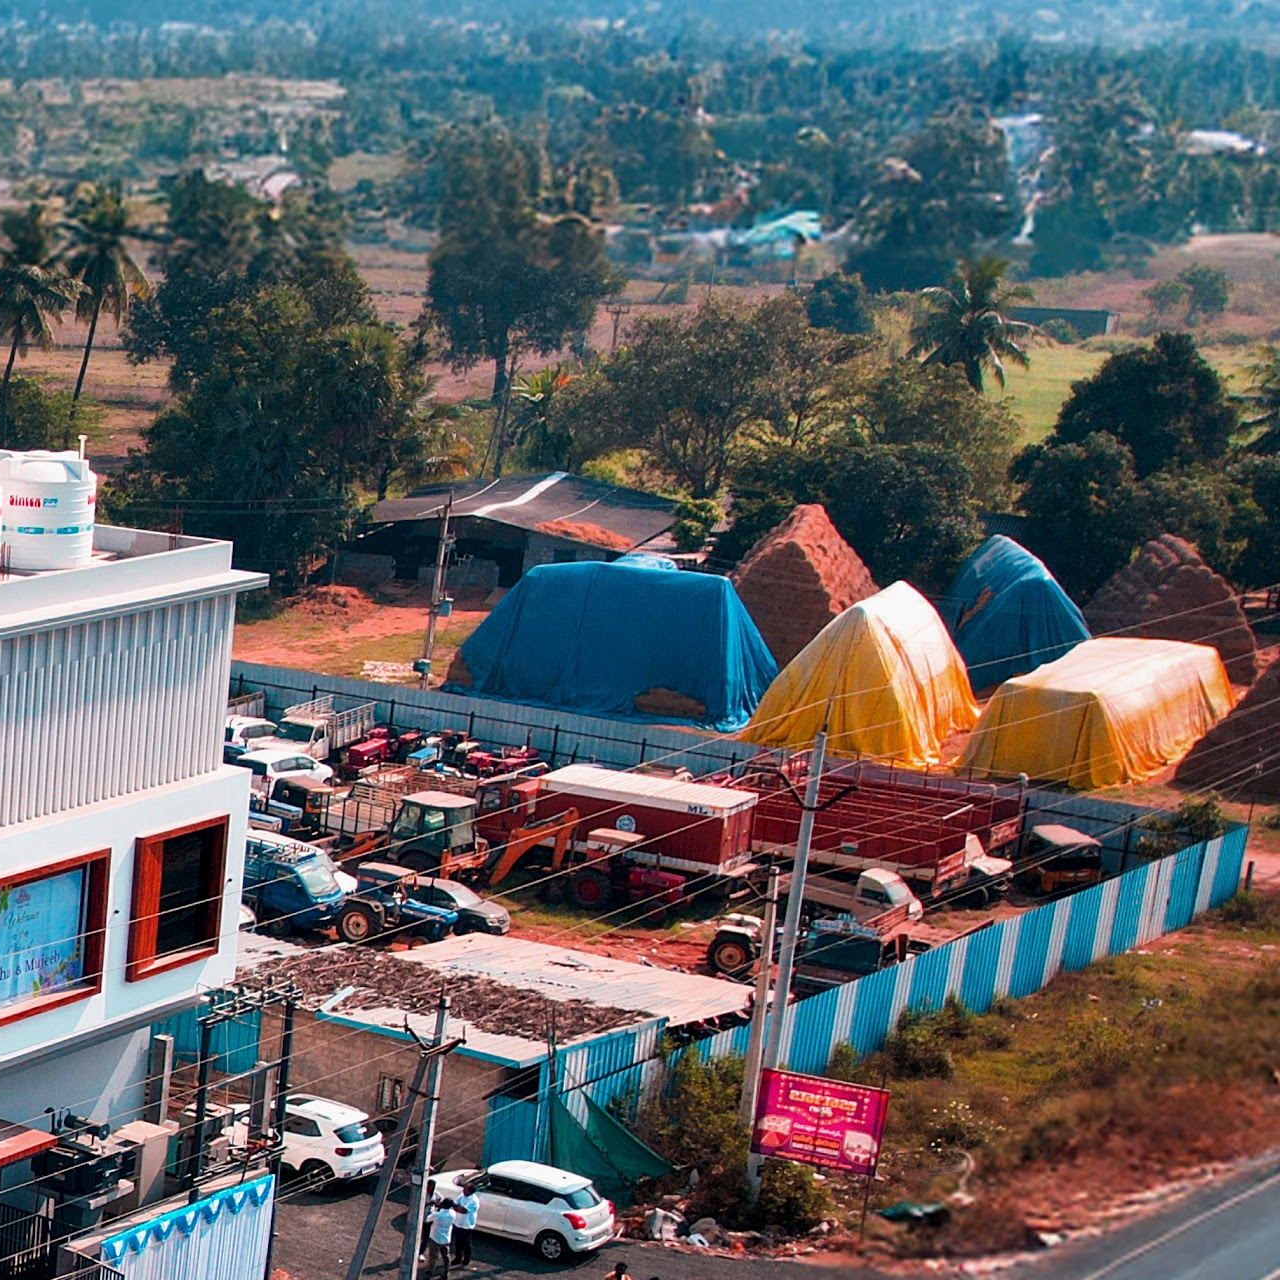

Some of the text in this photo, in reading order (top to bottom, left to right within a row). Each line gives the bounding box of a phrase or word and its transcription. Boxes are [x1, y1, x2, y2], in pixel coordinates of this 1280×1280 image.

[9, 495, 59, 508] Sintex pure
[4, 911, 40, 929] Welcome
[15, 964, 22, 976] &
[25, 950, 60, 971] Mujeeb
